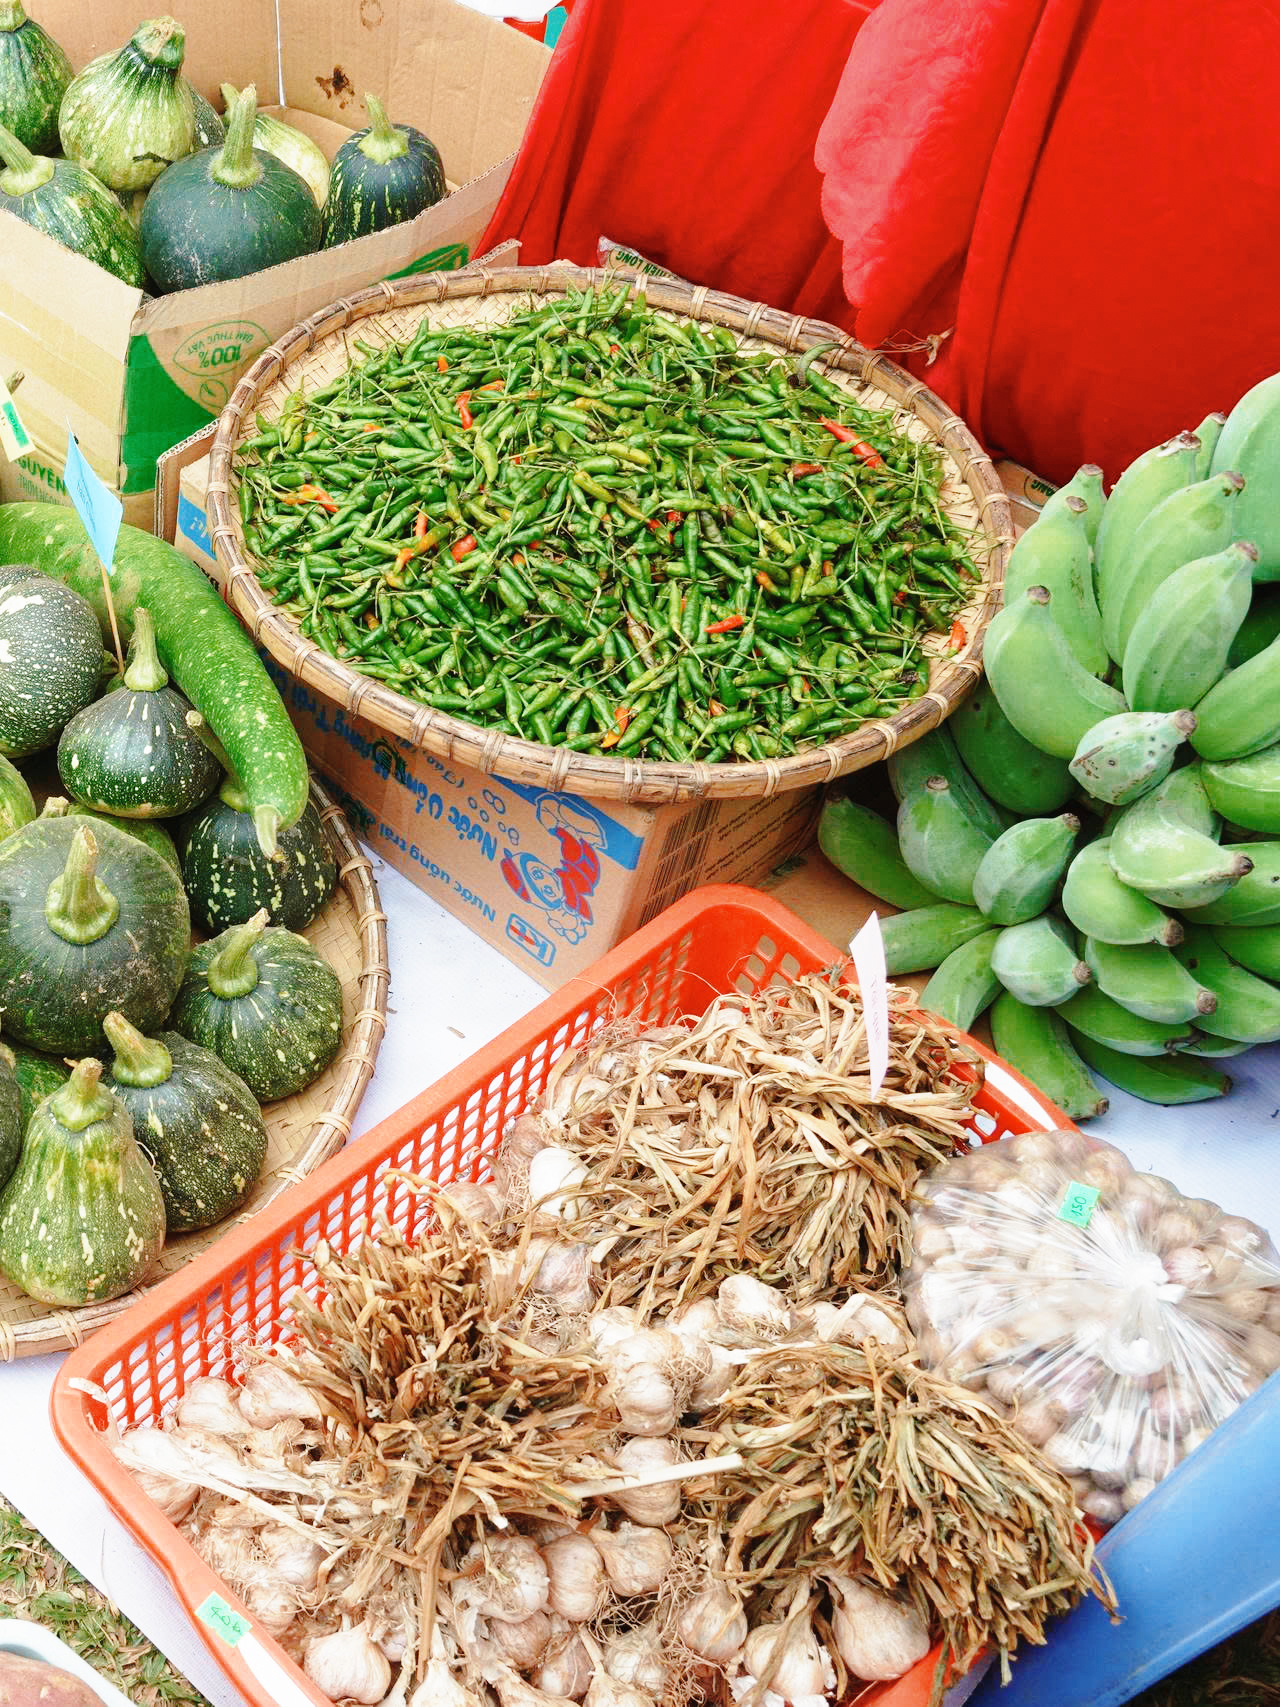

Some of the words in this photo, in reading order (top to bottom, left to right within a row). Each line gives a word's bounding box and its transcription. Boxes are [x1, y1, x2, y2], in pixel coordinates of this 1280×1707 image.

[616, 250, 643, 270] LONG
[198, 343, 242, 369] 100%
[409, 844, 451, 884] uống
[453, 881, 496, 922] Nước
[1071, 1196, 1087, 1217] 150
